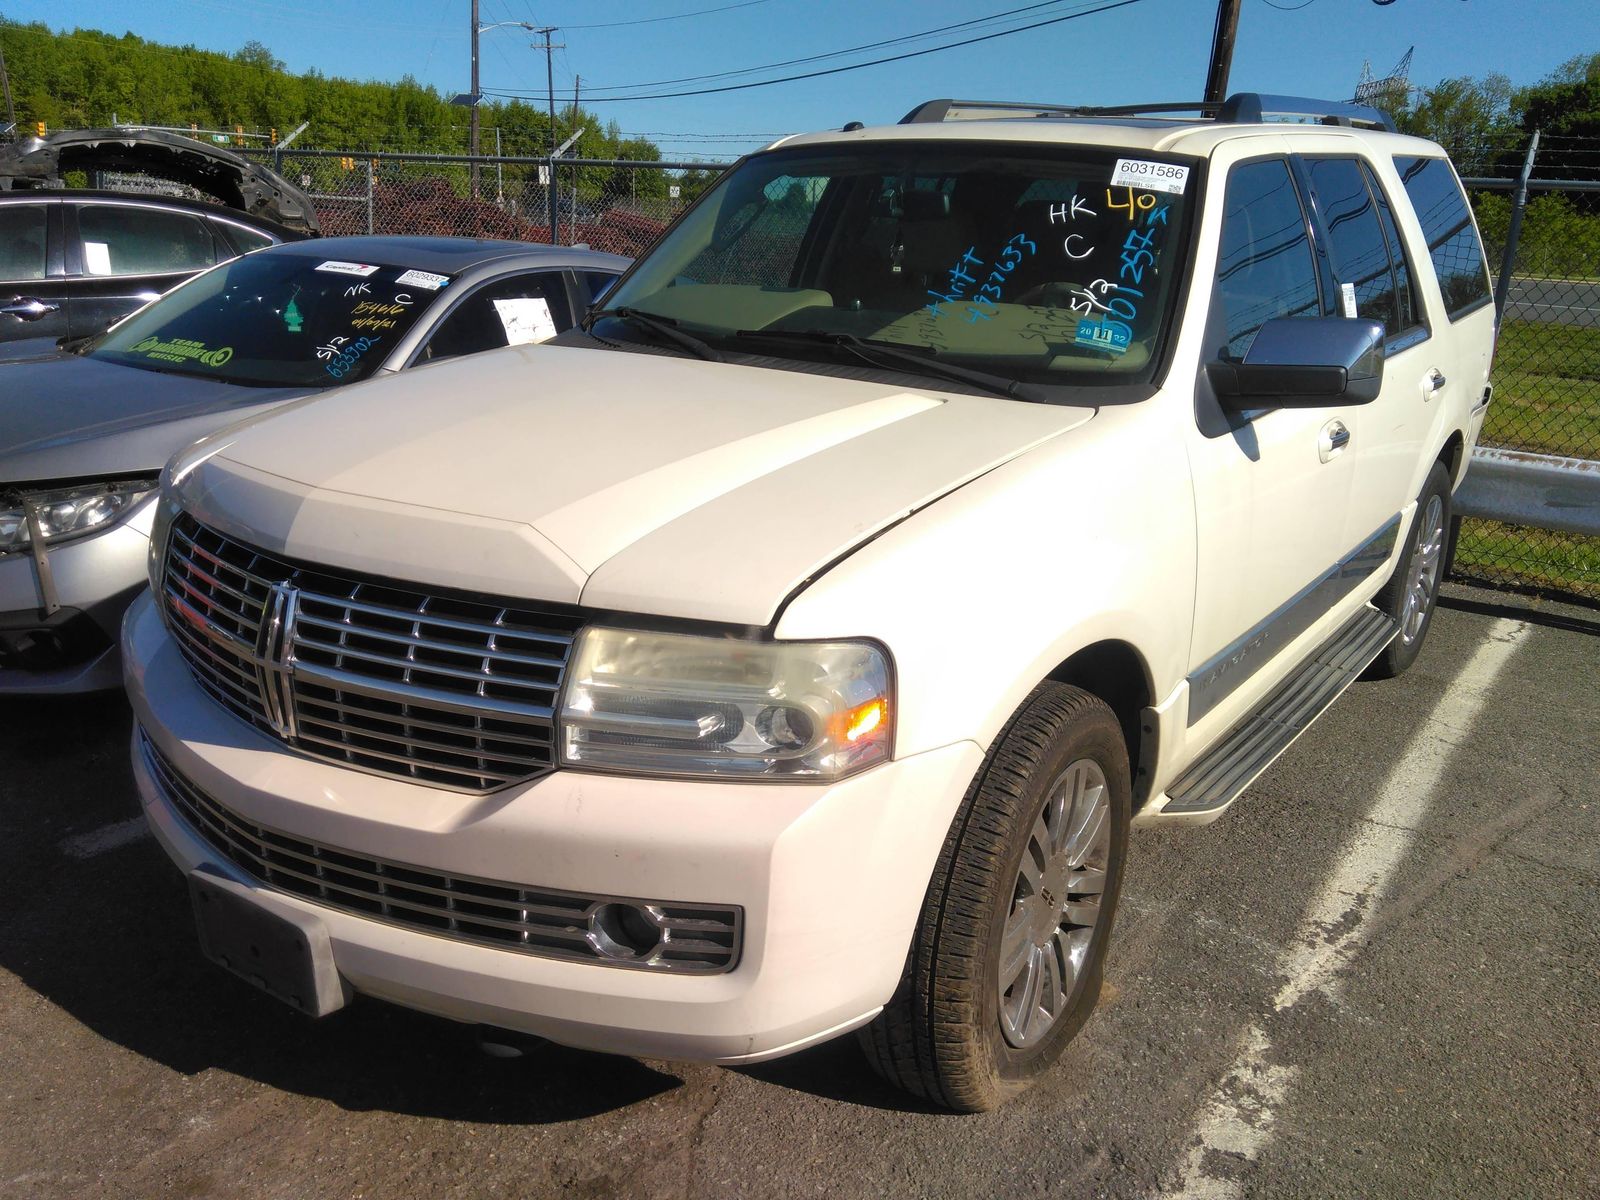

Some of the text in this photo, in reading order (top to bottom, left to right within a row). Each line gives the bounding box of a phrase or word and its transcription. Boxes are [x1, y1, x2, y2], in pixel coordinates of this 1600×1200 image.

[1120, 162, 1185, 180] 6031586
[1049, 194, 1097, 225] HK
[1106, 186, 1157, 220] 40
[1064, 233, 1095, 259] C
[343, 282, 372, 297] NK
[963, 233, 1036, 325] 4937633
[395, 293, 414, 305] C
[1069, 278, 1118, 317] 5/12
[315, 336, 350, 360] 5/12
[325, 336, 382, 378] 653902
